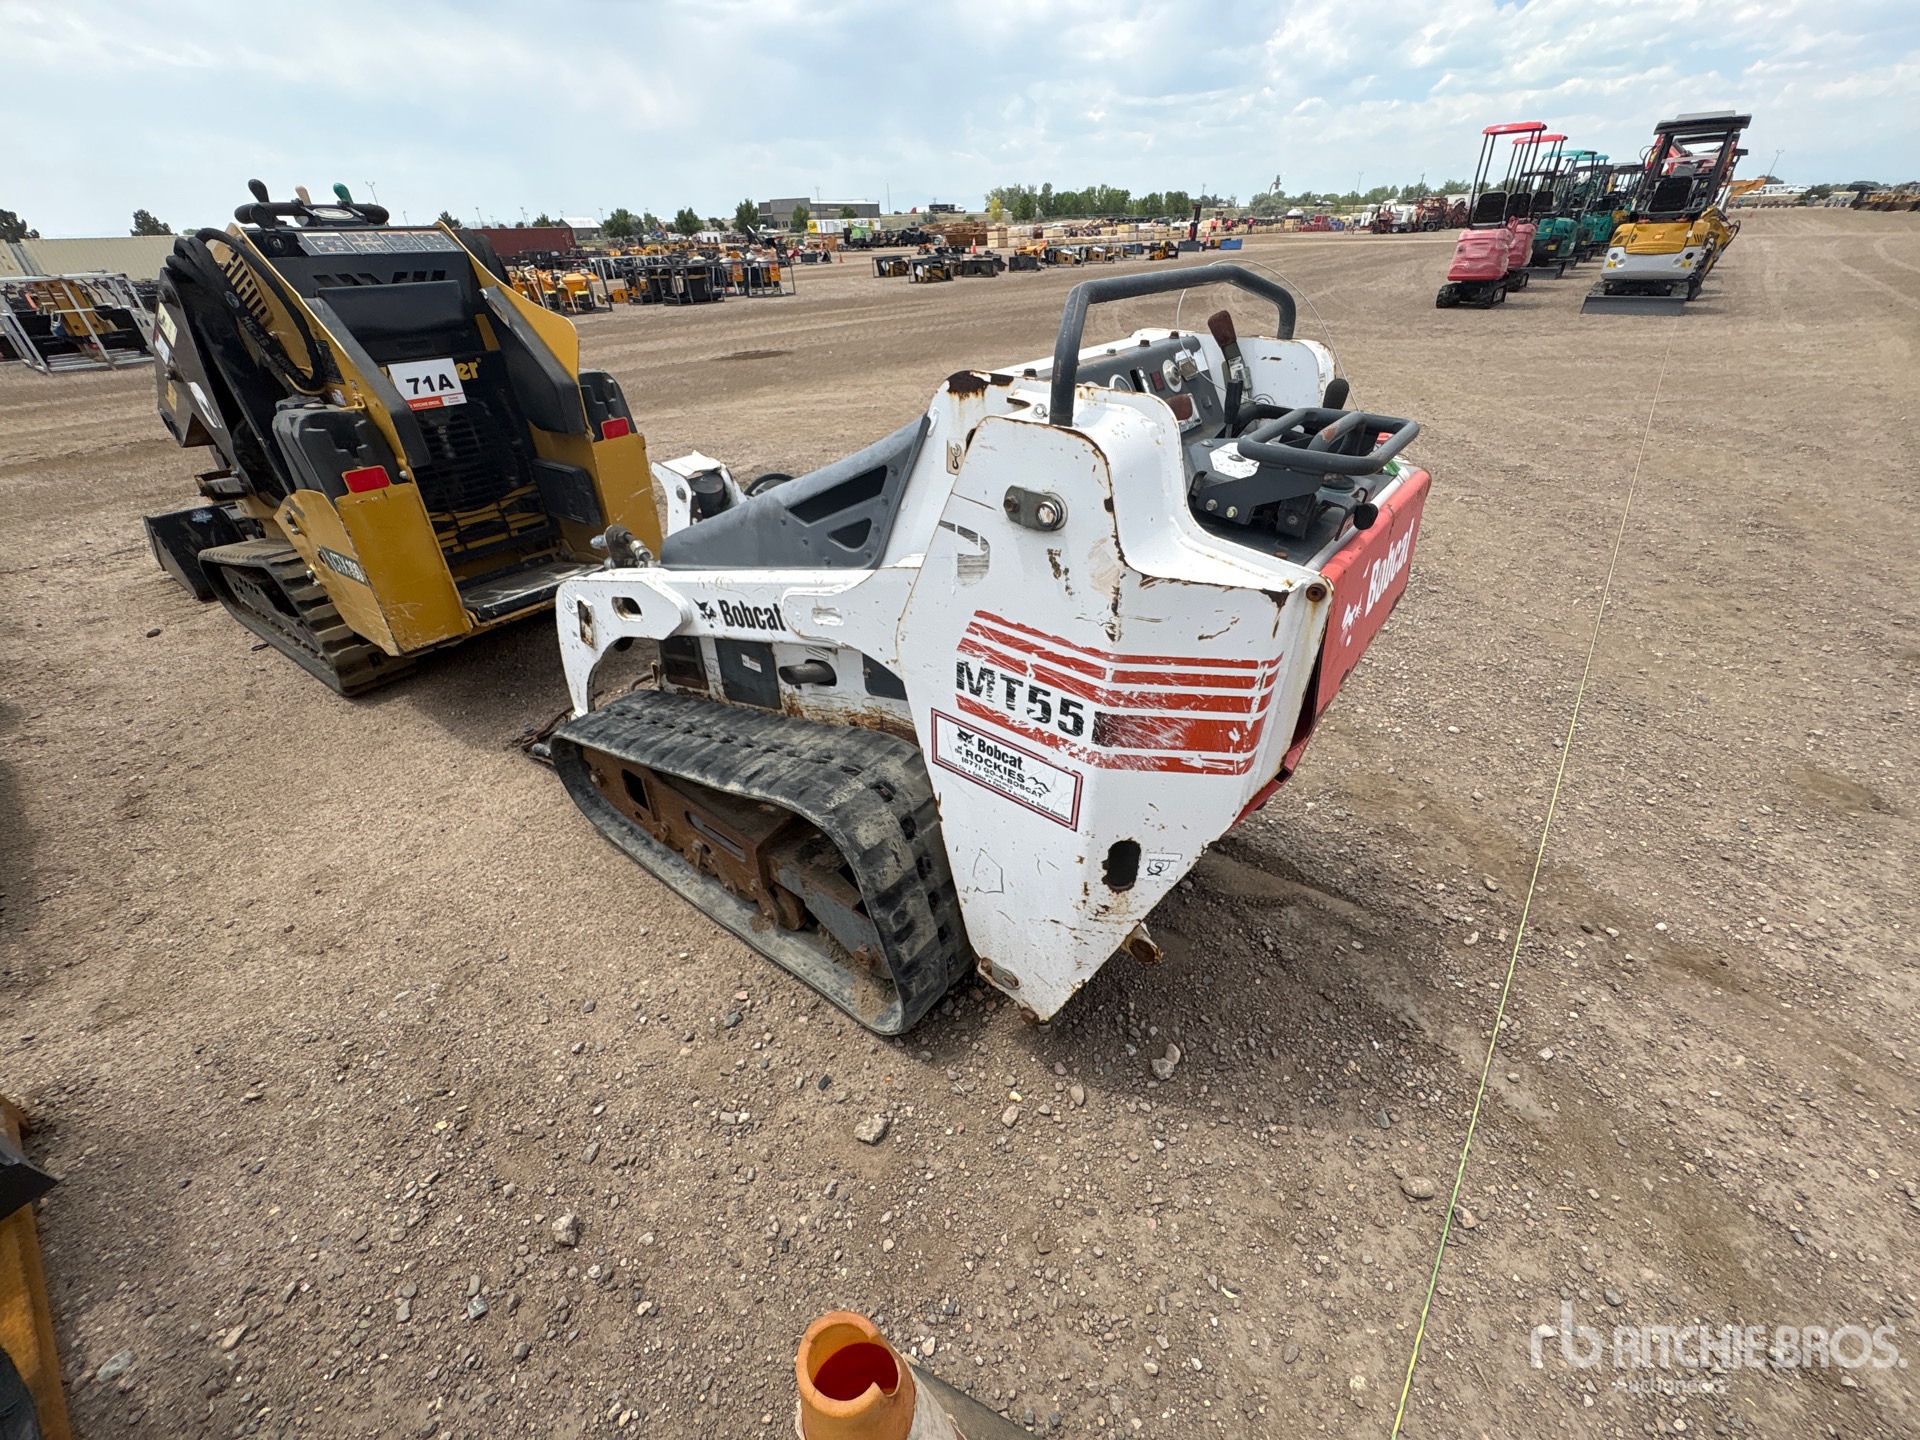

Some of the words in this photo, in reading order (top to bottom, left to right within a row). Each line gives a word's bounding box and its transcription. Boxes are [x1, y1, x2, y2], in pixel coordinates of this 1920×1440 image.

[405, 373, 455, 395] 71A
[1364, 517, 1415, 618] Bobcat
[717, 599, 787, 632] Bobcat
[955, 658, 1085, 737] MT55
[965, 748, 1026, 784] ROCKIES
[977, 737, 1024, 771] Bobcat
